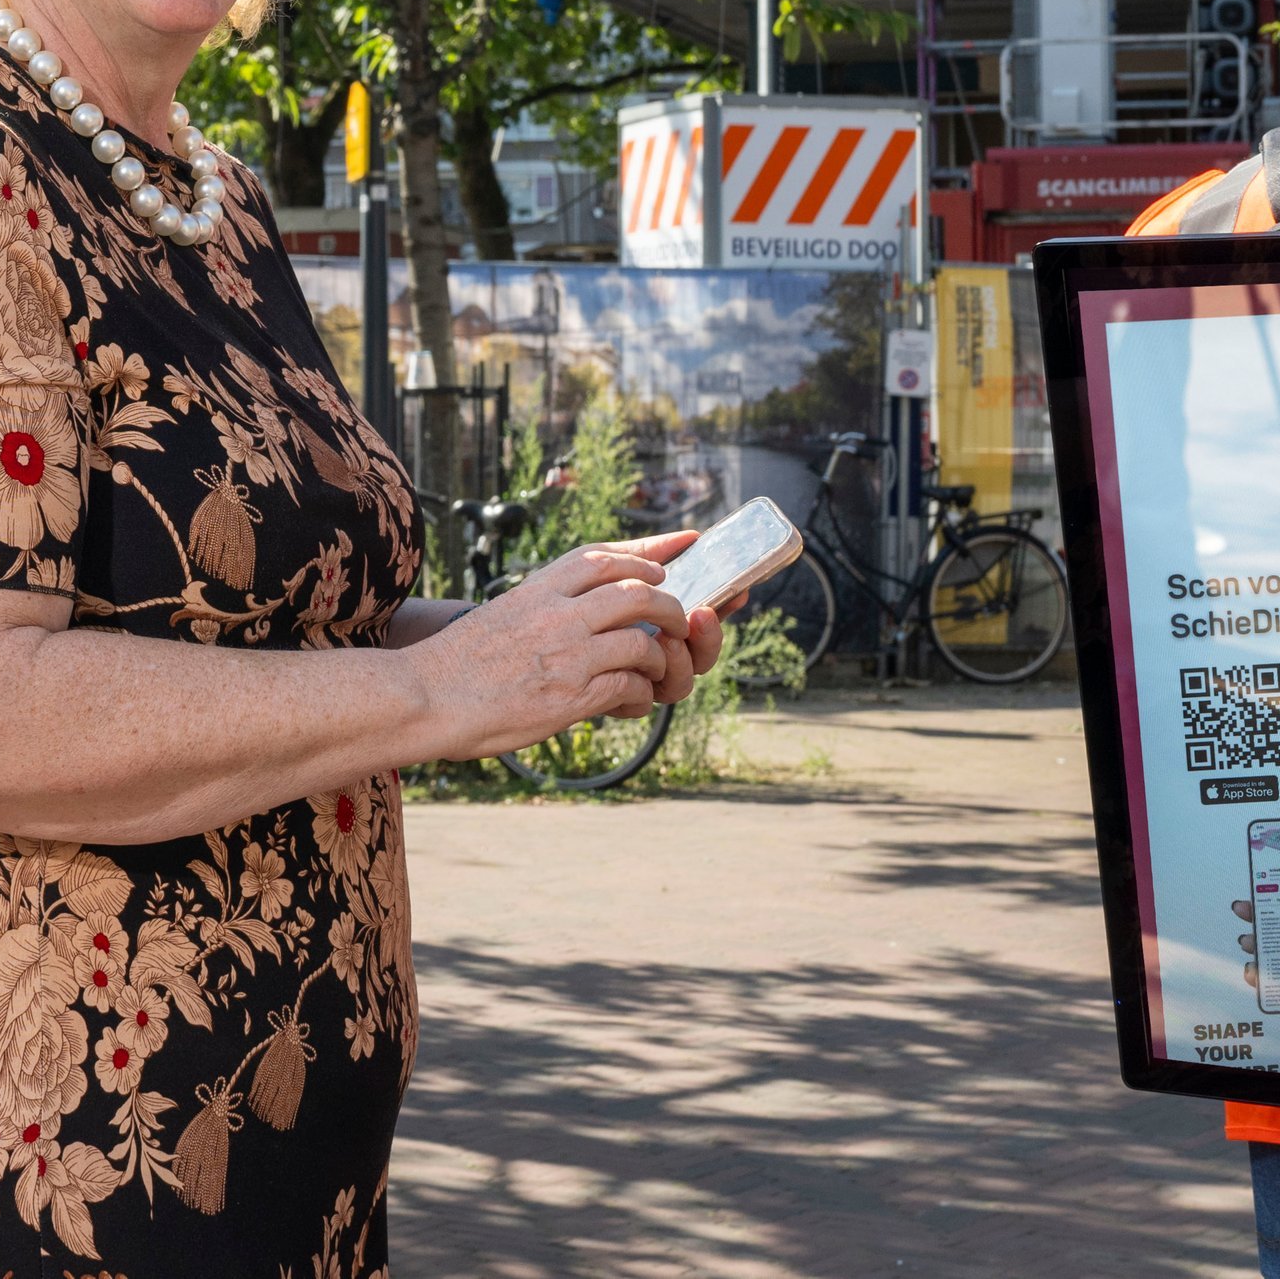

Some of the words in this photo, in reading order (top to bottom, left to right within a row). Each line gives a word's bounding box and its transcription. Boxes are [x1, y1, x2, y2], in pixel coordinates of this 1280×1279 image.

[731, 236, 841, 260] BEVEILIGD
[848, 239, 898, 260] DOO
[1167, 573, 1240, 600] Scan
[1222, 789, 1244, 800] App
[1245, 787, 1273, 798] Store
[1193, 1021, 1264, 1041] SHAPE
[1194, 1044, 1253, 1063] YOUR
